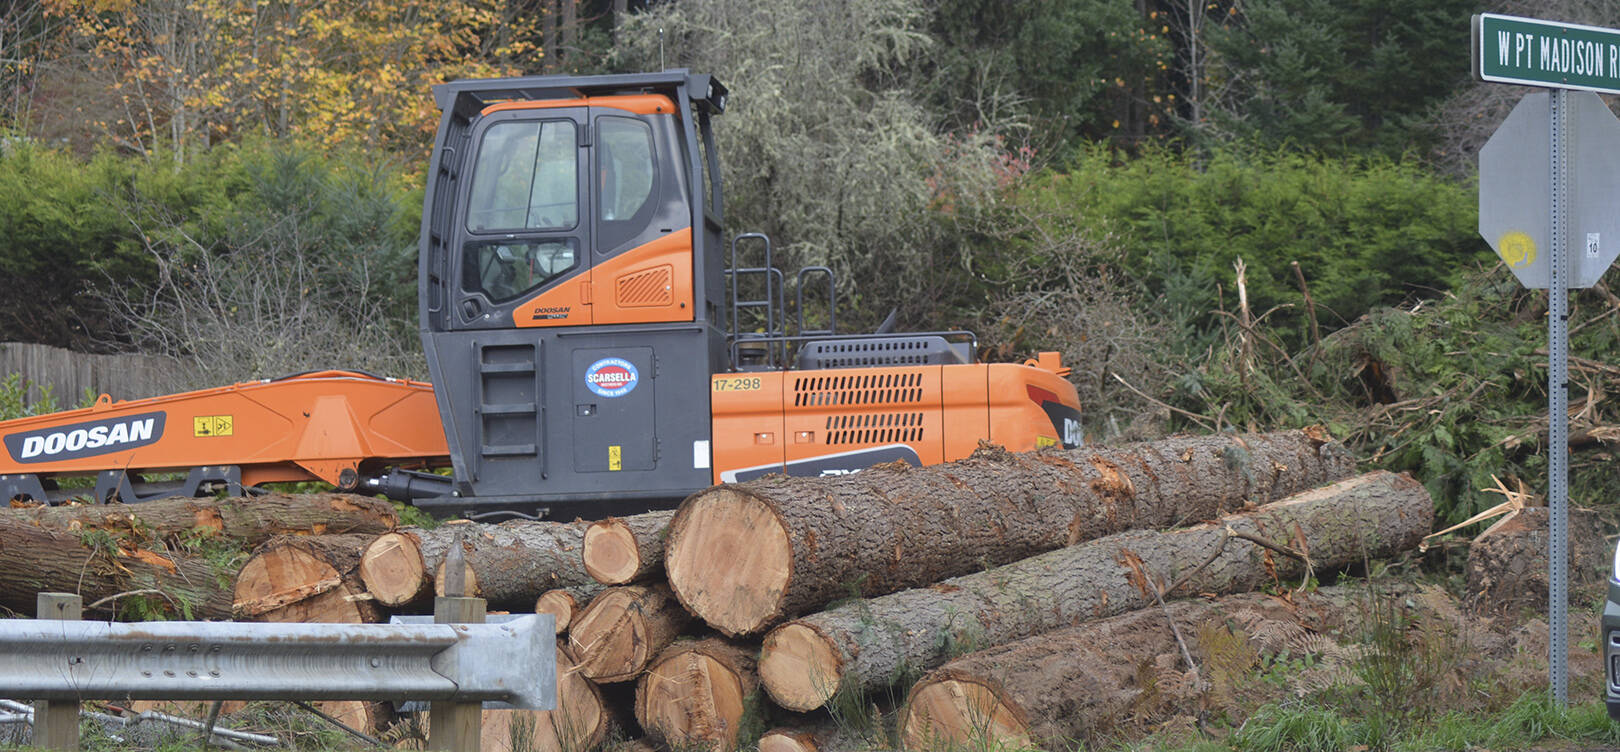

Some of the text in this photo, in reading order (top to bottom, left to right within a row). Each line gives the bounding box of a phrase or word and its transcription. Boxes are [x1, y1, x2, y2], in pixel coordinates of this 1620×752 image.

[1498, 30, 1620, 79] W PT MADISON R
[534, 306, 571, 314] DOOSAN
[588, 372, 636, 383] SCARSELLA
[713, 378, 760, 391] 17-298
[21, 418, 154, 458] DOOSAN
